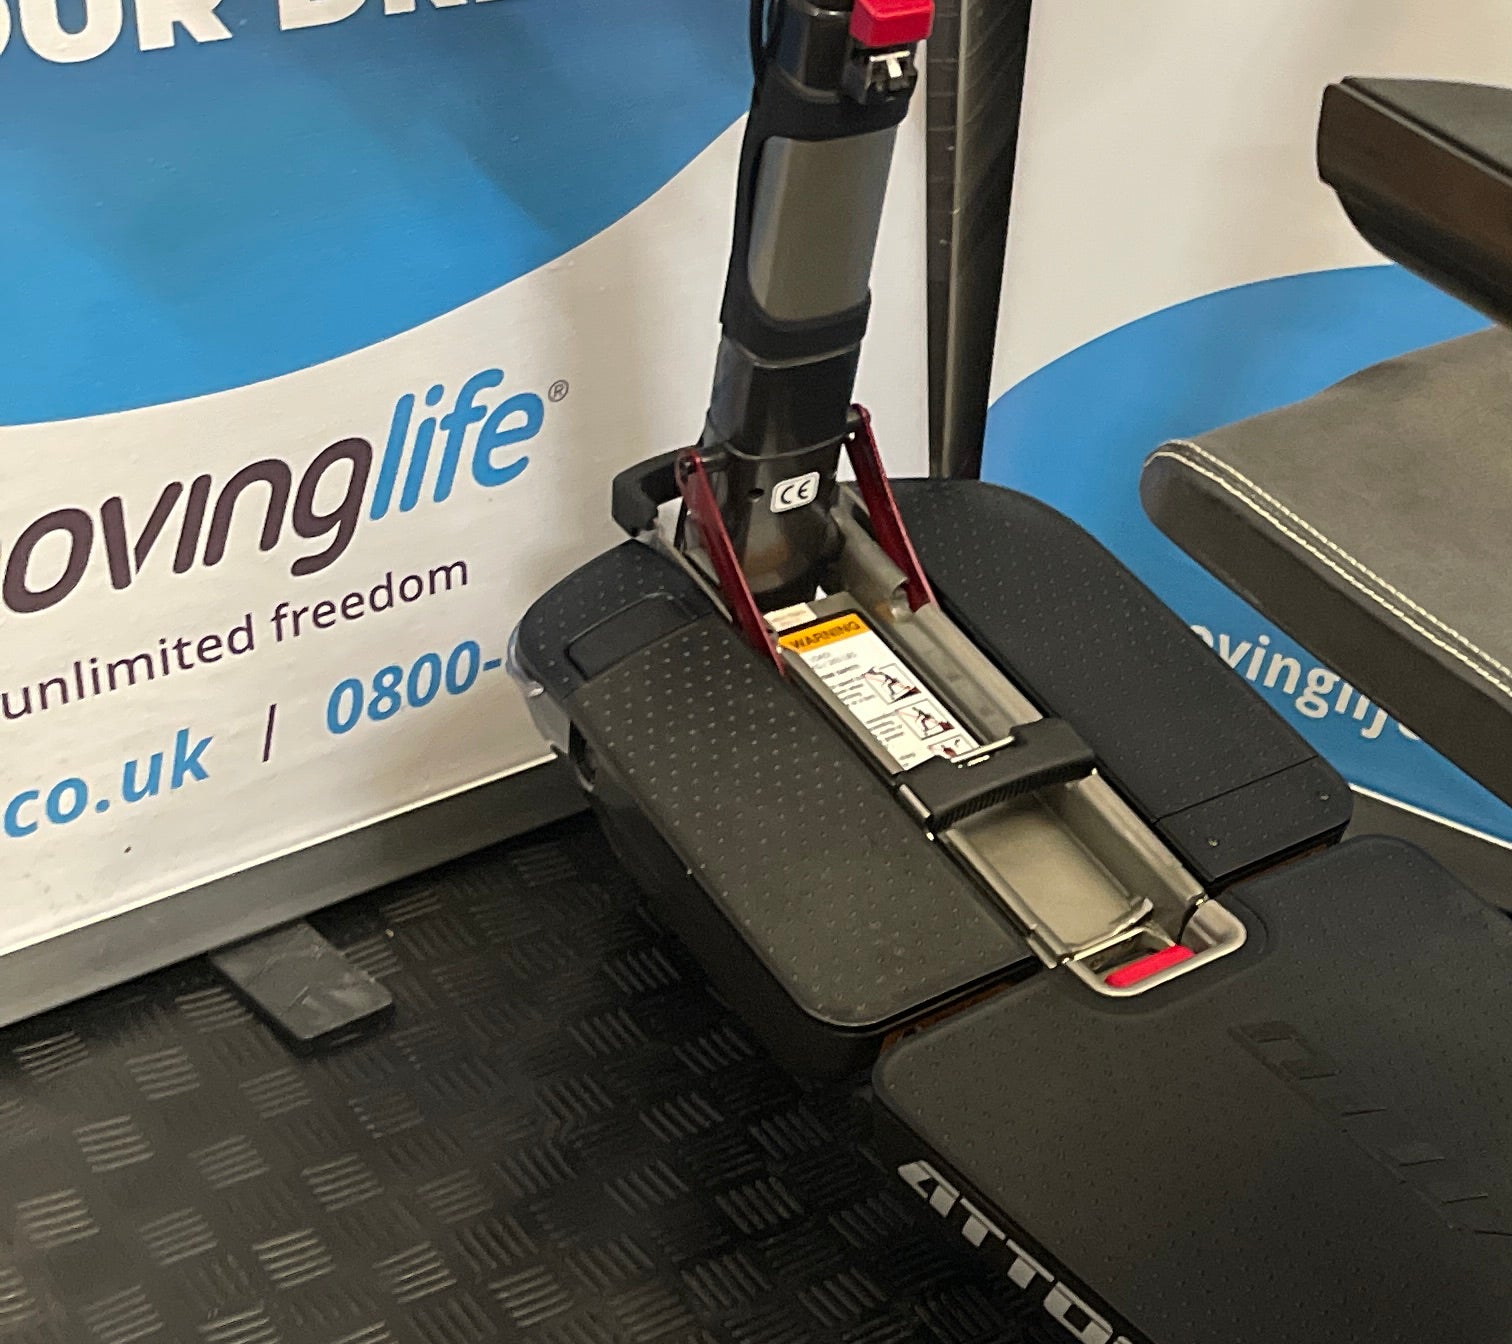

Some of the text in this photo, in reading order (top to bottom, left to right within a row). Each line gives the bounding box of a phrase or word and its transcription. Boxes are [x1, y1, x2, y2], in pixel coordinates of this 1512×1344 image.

[1, 559, 470, 720] unlimited freedom
[790, 621, 861, 648] WARNING
